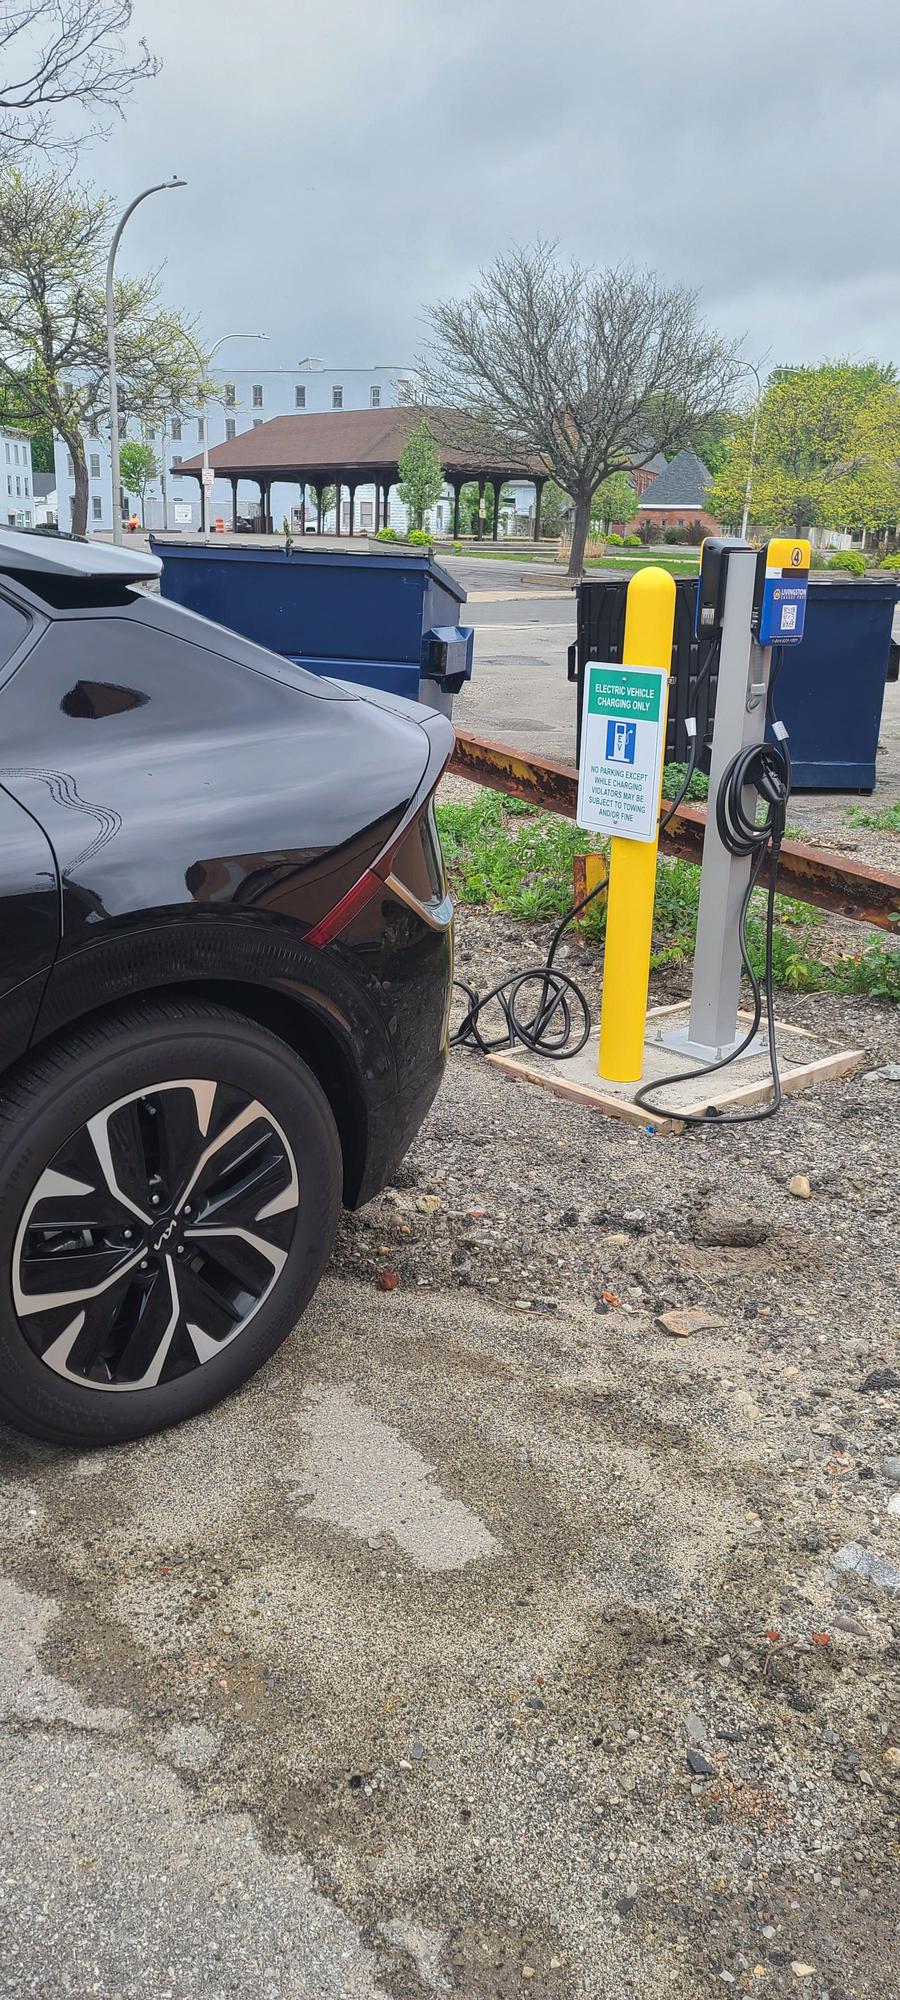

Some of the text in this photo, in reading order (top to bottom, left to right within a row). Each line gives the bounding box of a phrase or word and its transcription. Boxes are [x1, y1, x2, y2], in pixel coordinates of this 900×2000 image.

[781, 588, 807, 596] LIVINGSTON
[595, 683, 655, 699] ELECTRIC VEHICLE
[597, 696, 650, 712] CHARGING ONLY
[591, 766, 648, 782] NO PARKING EXCEPT
[595, 777, 642, 792] WHILE CHARGING
[592, 786, 644, 803] VIOLATORS MAY BE
[589, 796, 646, 814] SUBJECT TO TOWING
[599, 808, 634, 822] AND/OR FINE
